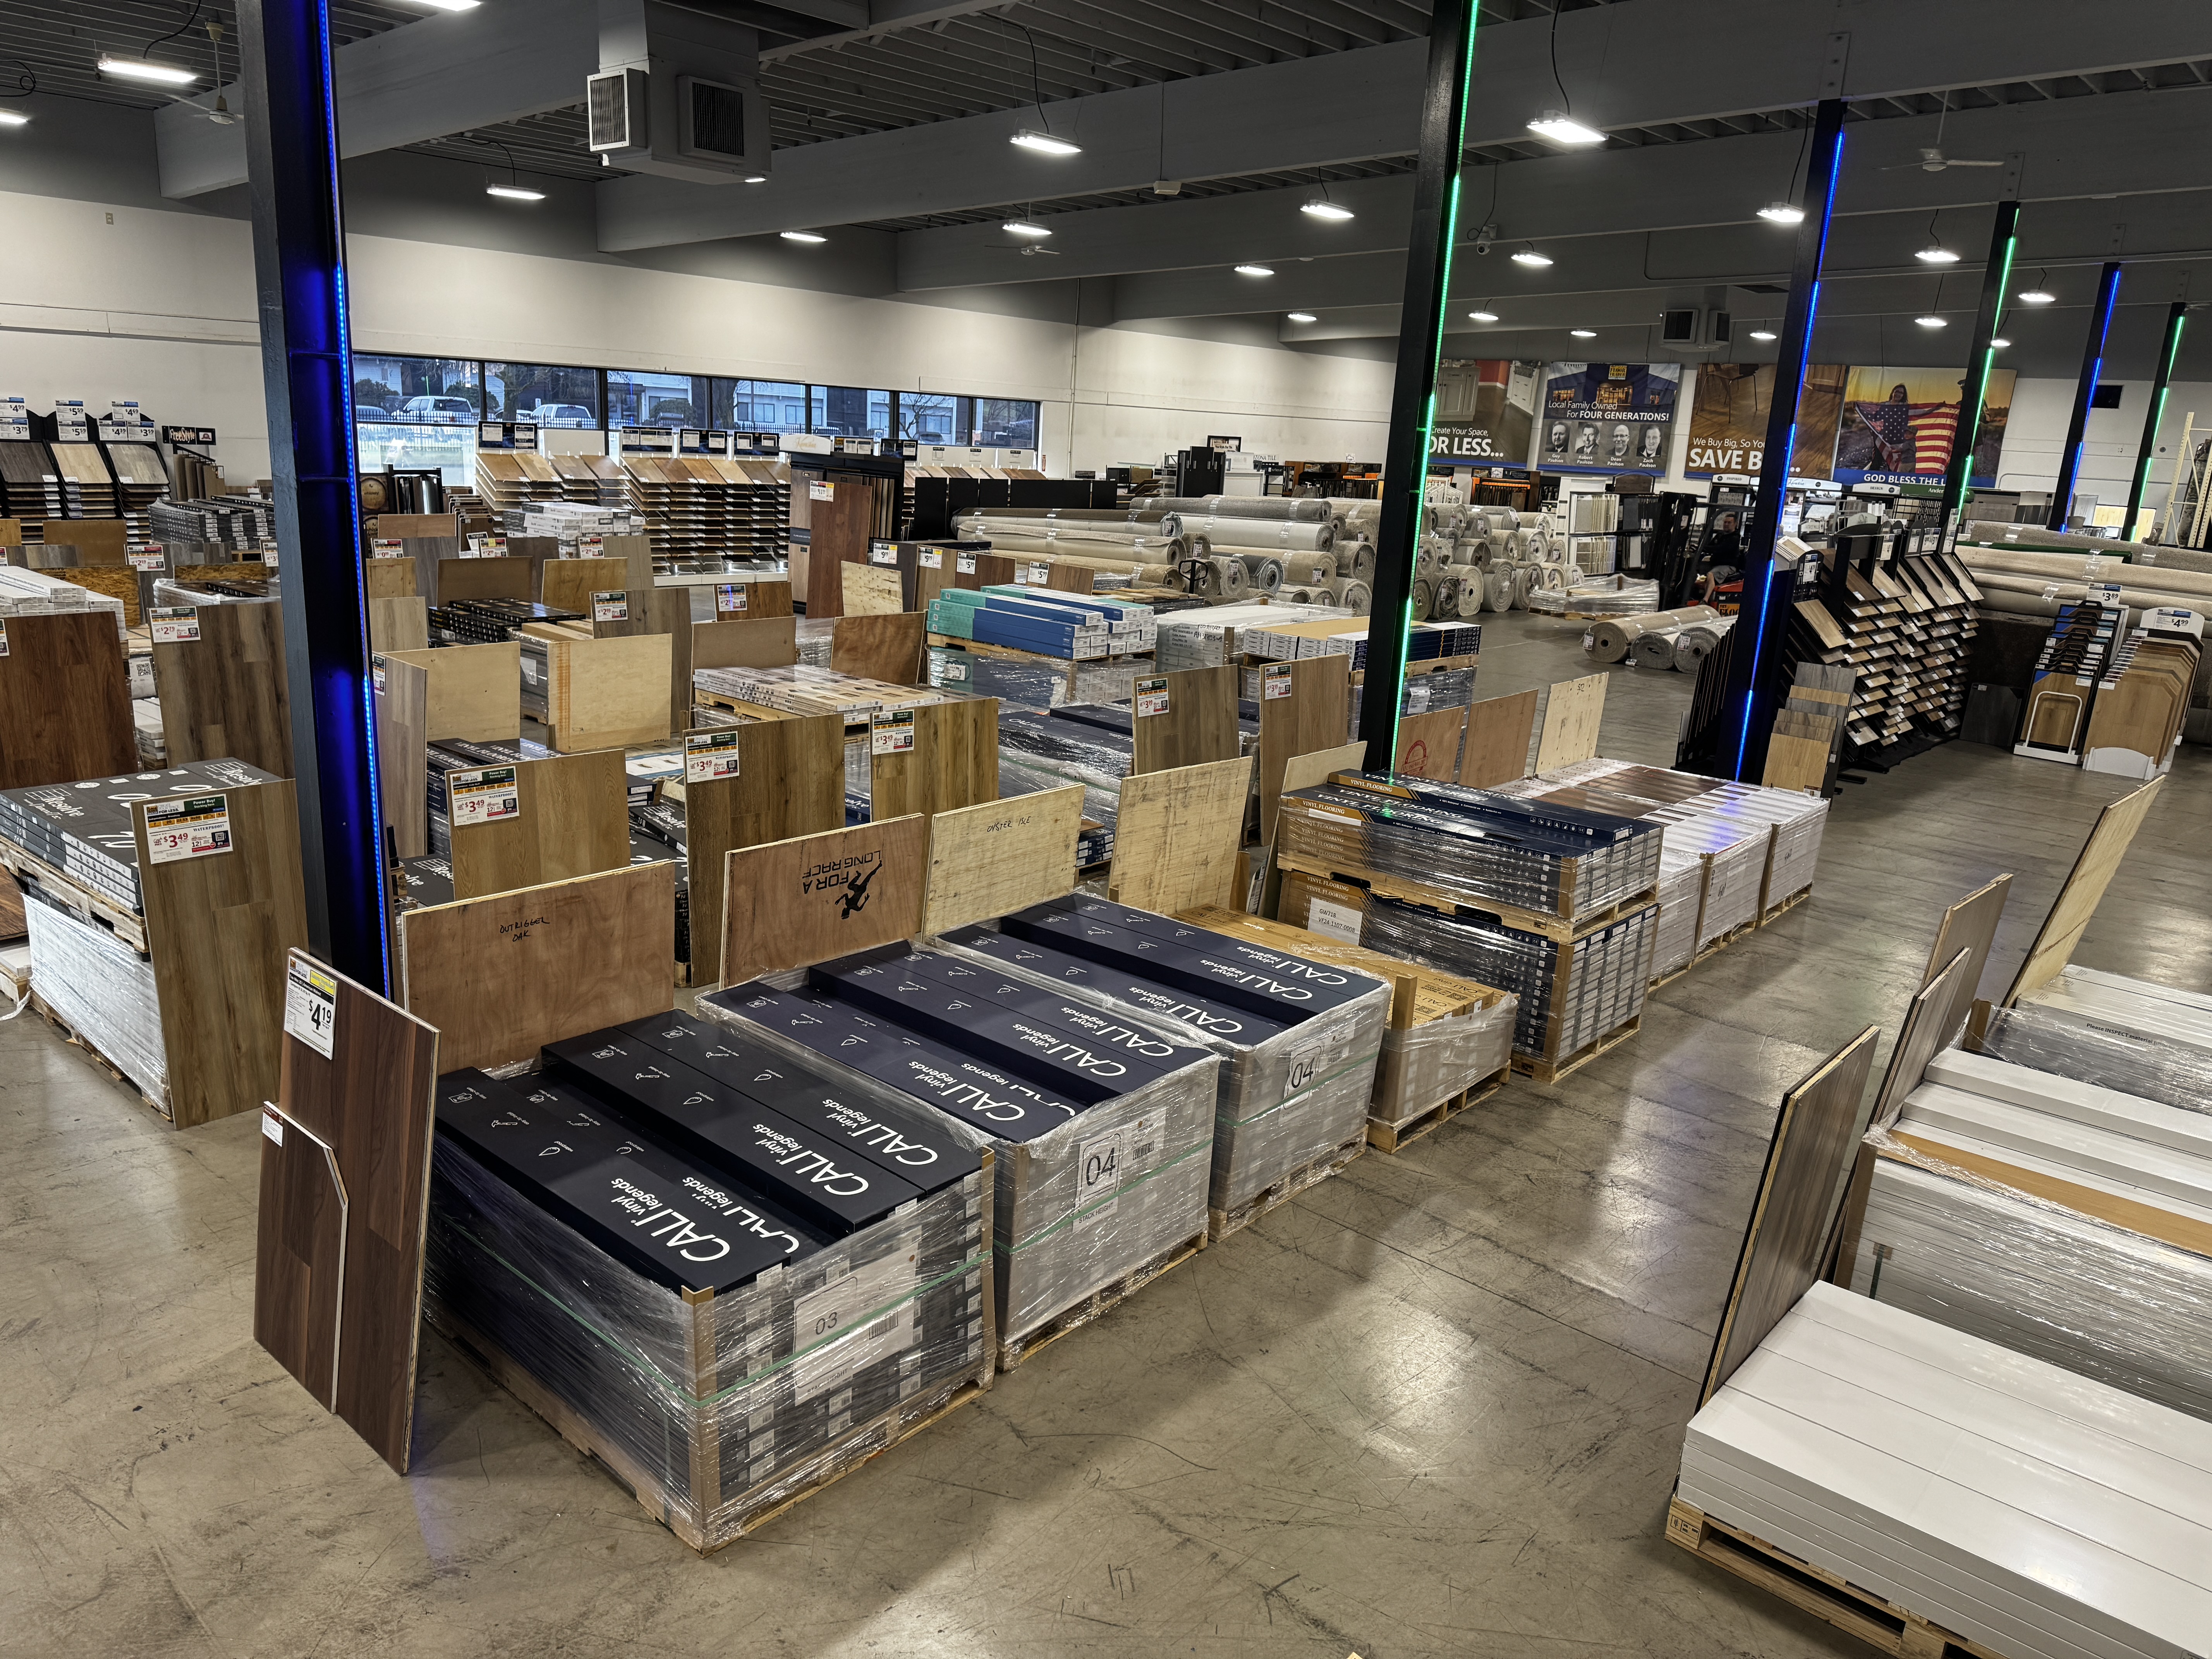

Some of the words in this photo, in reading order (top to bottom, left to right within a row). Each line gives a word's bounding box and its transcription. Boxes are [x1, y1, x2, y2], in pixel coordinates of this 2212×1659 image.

[1549, 400, 1566, 409] Local
[1568, 401, 1590, 411] Family
[1591, 401, 1618, 410] Owned
[1567, 410, 1579, 418] For
[1580, 410, 1602, 419] FOUR
[1604, 411, 1669, 421] GENERATIONS!
[1468, 428, 1489, 437] Space,
[1429, 436, 1449, 454] OR
[1453, 437, 1504, 457] LESS...
[1693, 437, 1706, 446] We
[1708, 438, 1723, 448] Buy
[1724, 438, 1738, 449] Big,
[1740, 439, 1751, 448] So
[1689, 448, 1743, 469] SAVE
[1864, 474, 1886, 483] GOD
[1888, 475, 1916, 484] BLESS
[1919, 477, 1939, 485] THE
[1365, 774, 1401, 785] VINYL
[1403, 781, 1489, 802] FLOORING
[1366, 781, 1393, 792] FLOORING
[1401, 774, 1443, 784] VINYL
[37, 796, 85, 817] Resolve
[1303, 800, 1318, 809] VINYL
[1319, 804, 1345, 814] FLOORING
[1317, 794, 1360, 806] VINYL
[1361, 804, 1444, 824] FLOORING
[1340, 789, 1381, 802] VINYL
[1384, 799, 1464, 818] FLOORING
[986, 820, 1012, 833] OYSTER
[1018, 816, 1032, 827] ISLE
[1317, 822, 1343, 833] FLOORING
[1302, 828, 1317, 836] VINYL
[1318, 831, 1344, 843] FLOORING
[1302, 836, 1317, 845] VINYL
[1317, 840, 1343, 852] FLOORING
[844, 850, 881, 870] LONG
[802, 881, 810, 894] A
[816, 871, 850, 890] FOR
[1307, 876, 1322, 884] VINYL
[1323, 880, 1349, 891] FLOORING
[1307, 885, 1322, 893] VINYL
[1322, 889, 1348, 901] FLOORING
[1191, 911, 1211, 920] CALI
[1319, 909, 1336, 918] GW718
[1318, 917, 1355, 933] VF24-1107-0008
[512, 929, 530, 942] OAK
[1237, 946, 1285, 965] legends
[1248, 953, 1275, 967] vinyl
[1200, 959, 1248, 979] legends
[1211, 968, 1239, 983] vinyl
[1270, 959, 1348, 985] CALI
[1234, 974, 1312, 1000] CALI
[1433, 977, 1451, 986] vinyl
[1454, 984, 1478, 994] CALI
[1129, 986, 1176, 1008] legends
[1138, 996, 1168, 1011] vinyl
[1429, 998, 1447, 1008] CALI
[1061, 1007, 1110, 1027] legends
[1069, 1017, 1098, 1032] vinyl
[1164, 1003, 1242, 1033] CALI
[1012, 1023, 1061, 1047] legends
[1020, 1034, 1051, 1051] vinyl
[1092, 1025, 1173, 1057] CALI
[2087, 1023, 2104, 1032] Please
[2105, 1027, 2129, 1038] INSPECT
[2130, 1034, 2153, 1044] material
[1046, 1044, 1126, 1077] CALI
[909, 1061, 958, 1085] legends
[915, 1073, 946, 1090] vinyl
[961, 1063, 1010, 1086] legends
[1291, 1057, 1314, 1088] 04
[941, 1083, 1025, 1121] CALI
[823, 1099, 872, 1125] legends
[826, 1113, 858, 1130] vinyl
[752, 1123, 802, 1152] legends
[851, 1123, 938, 1165] CALI
[756, 1139, 787, 1156] vinyl
[780, 1149, 869, 1195] CALI
[1086, 1147, 1116, 1187] 04
[611, 1177, 663, 1211] legends
[682, 1176, 733, 1207] legends
[611, 1195, 646, 1216] vinyl
[1079, 1212, 1095, 1224] STACK
[1095, 1202, 1114, 1219] HEIGHT
[635, 1208, 730, 1262] CALI
[816, 1311, 838, 1336] 03
[828, 1367, 848, 1384] HEIGHT
